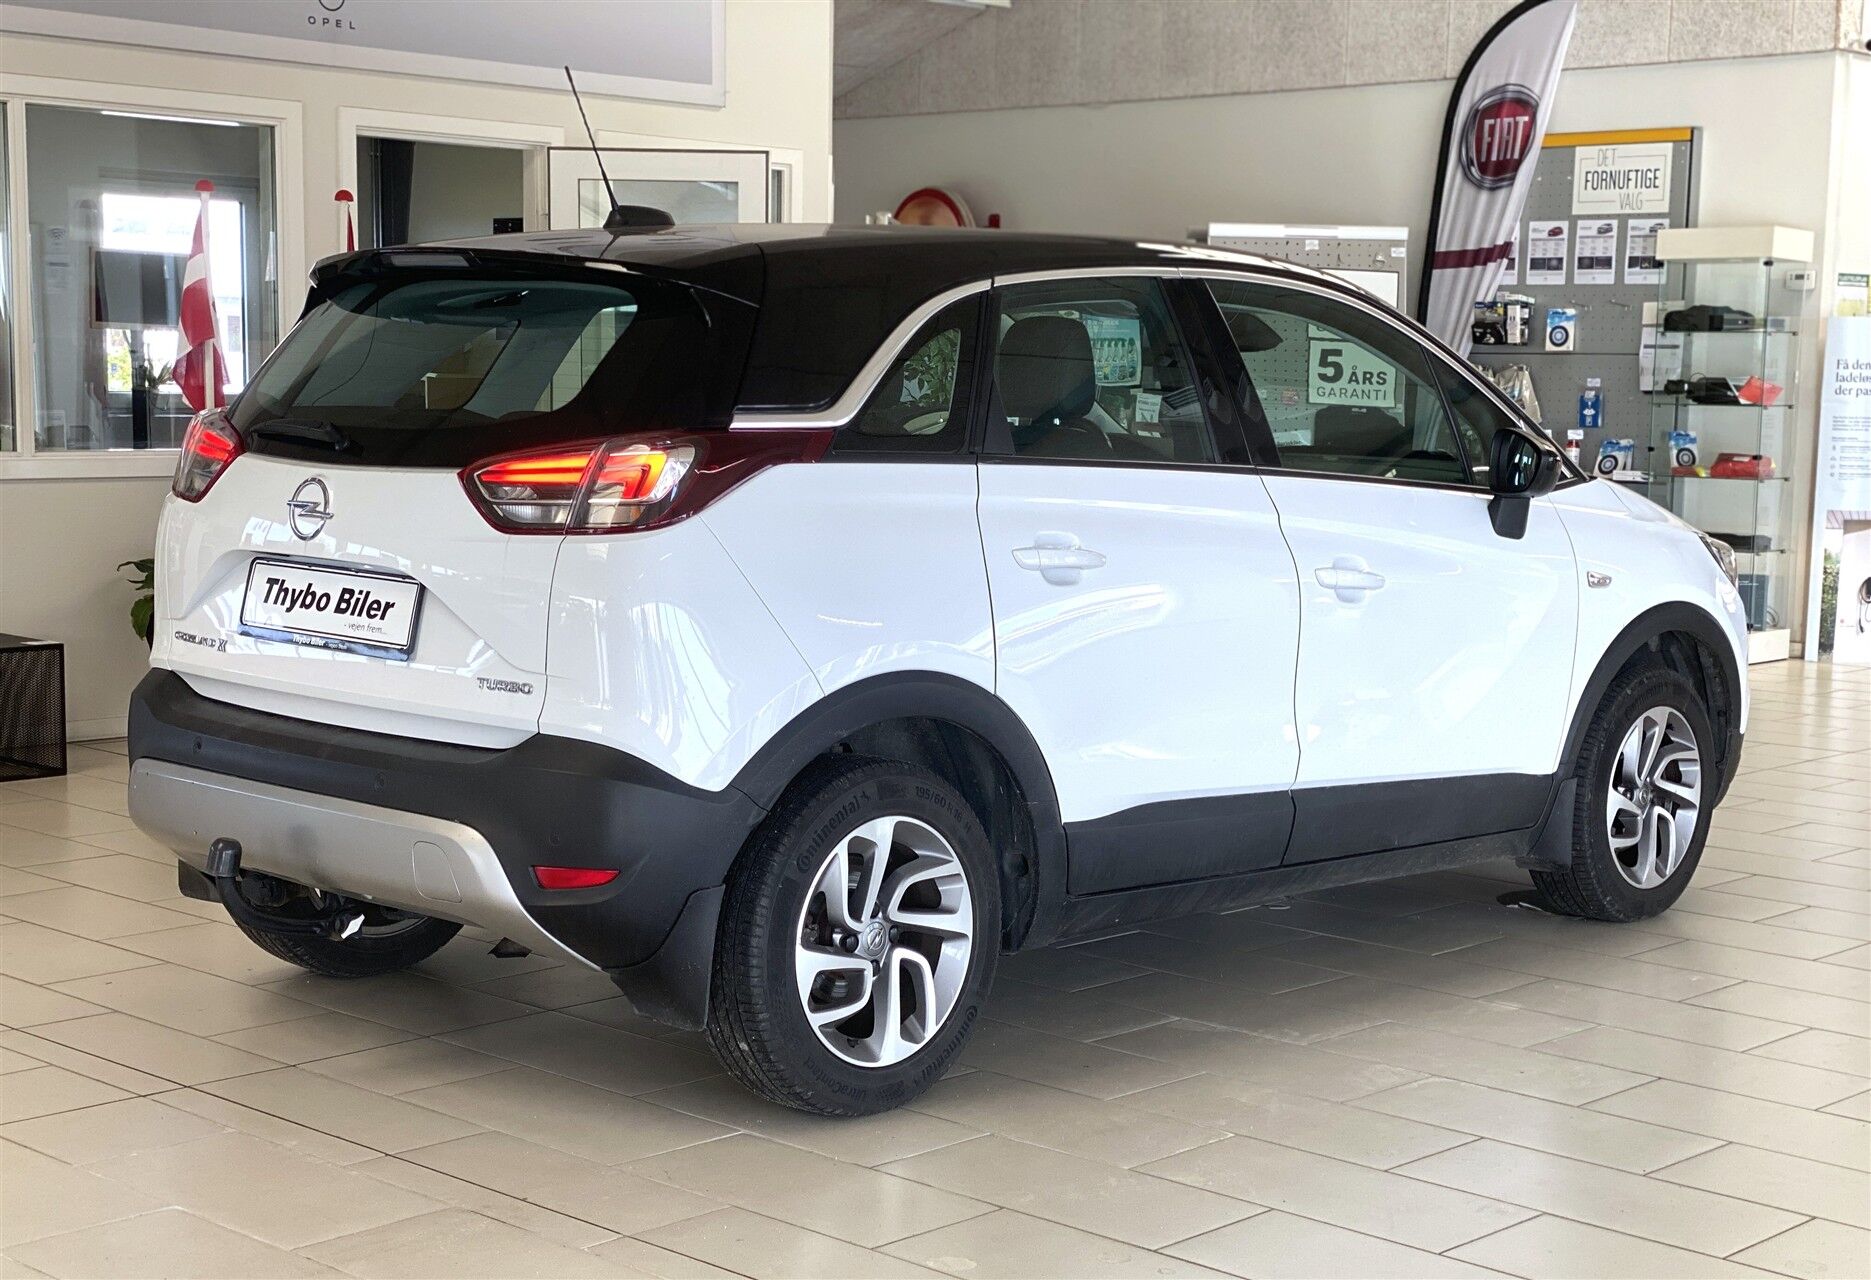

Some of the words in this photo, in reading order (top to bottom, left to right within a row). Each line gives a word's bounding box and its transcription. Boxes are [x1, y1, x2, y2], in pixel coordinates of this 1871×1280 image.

[307, 15, 356, 30] OPEL
[1480, 115, 1530, 163] FIAT
[1597, 147, 1618, 168] DET
[1583, 168, 1661, 191] FORNUFTIGE
[1618, 192, 1644, 211] VALG
[1317, 348, 1344, 384] 5
[1347, 364, 1388, 386] ÅRS
[1316, 386, 1388, 401] GARANTI
[1834, 384, 1853, 396] der
[263, 577, 331, 613] Thybo
[333, 587, 396, 621] Biler
[216, 637, 228, 653] X
[476, 676, 534, 696] TURBO
[796, 795, 862, 873] Continental
